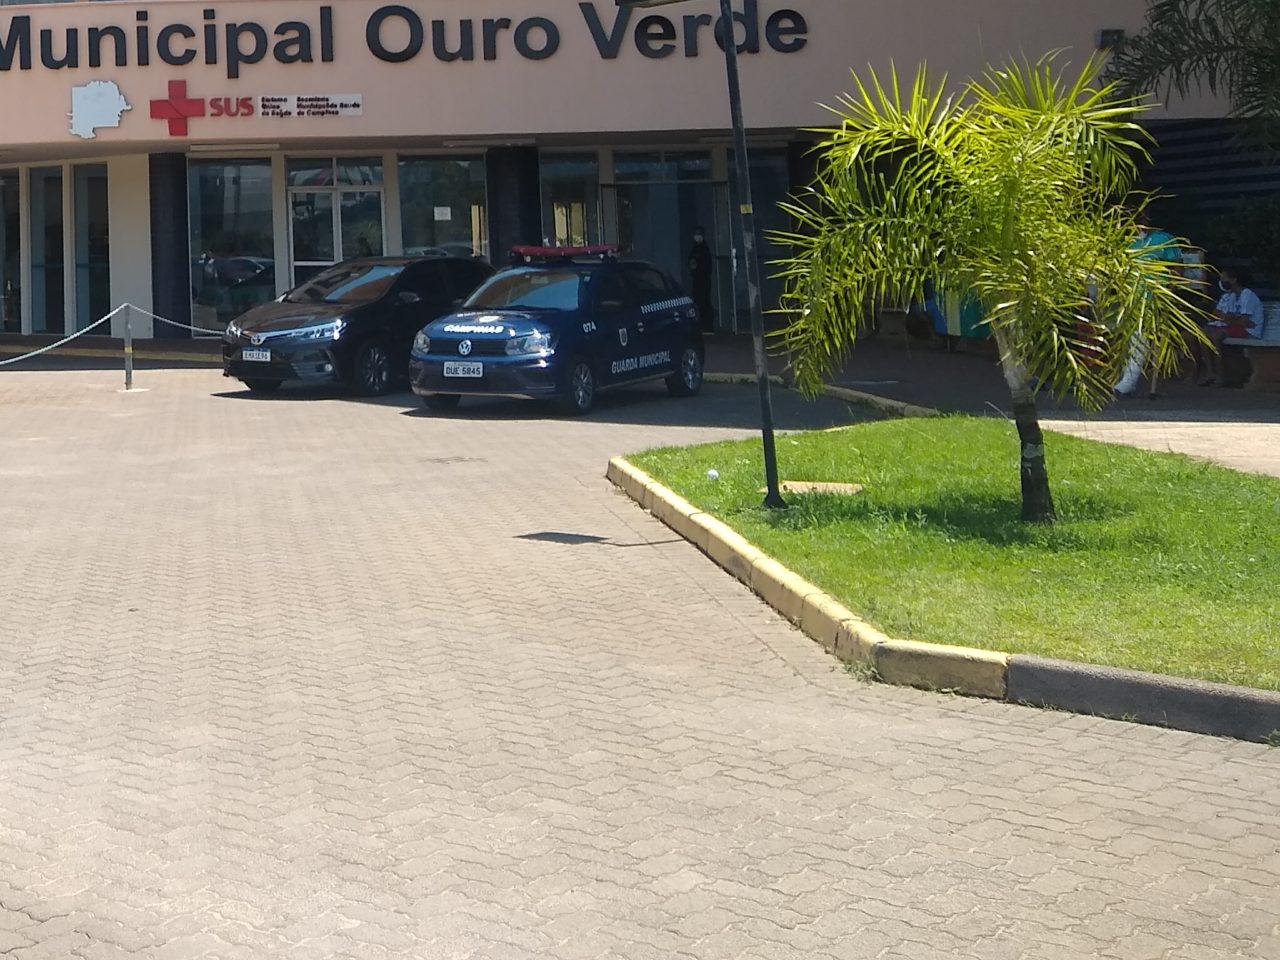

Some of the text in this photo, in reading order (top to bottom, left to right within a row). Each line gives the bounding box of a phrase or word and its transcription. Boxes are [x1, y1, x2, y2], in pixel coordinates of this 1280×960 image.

[366, 4, 561, 63] Ouro
[209, 96, 255, 117] SUS
[443, 324, 504, 334] CAMPINAS
[582, 321, 597, 333] 074
[611, 350, 671, 374] GUARDA MUNICIPAL
[445, 366, 460, 375] DUE
